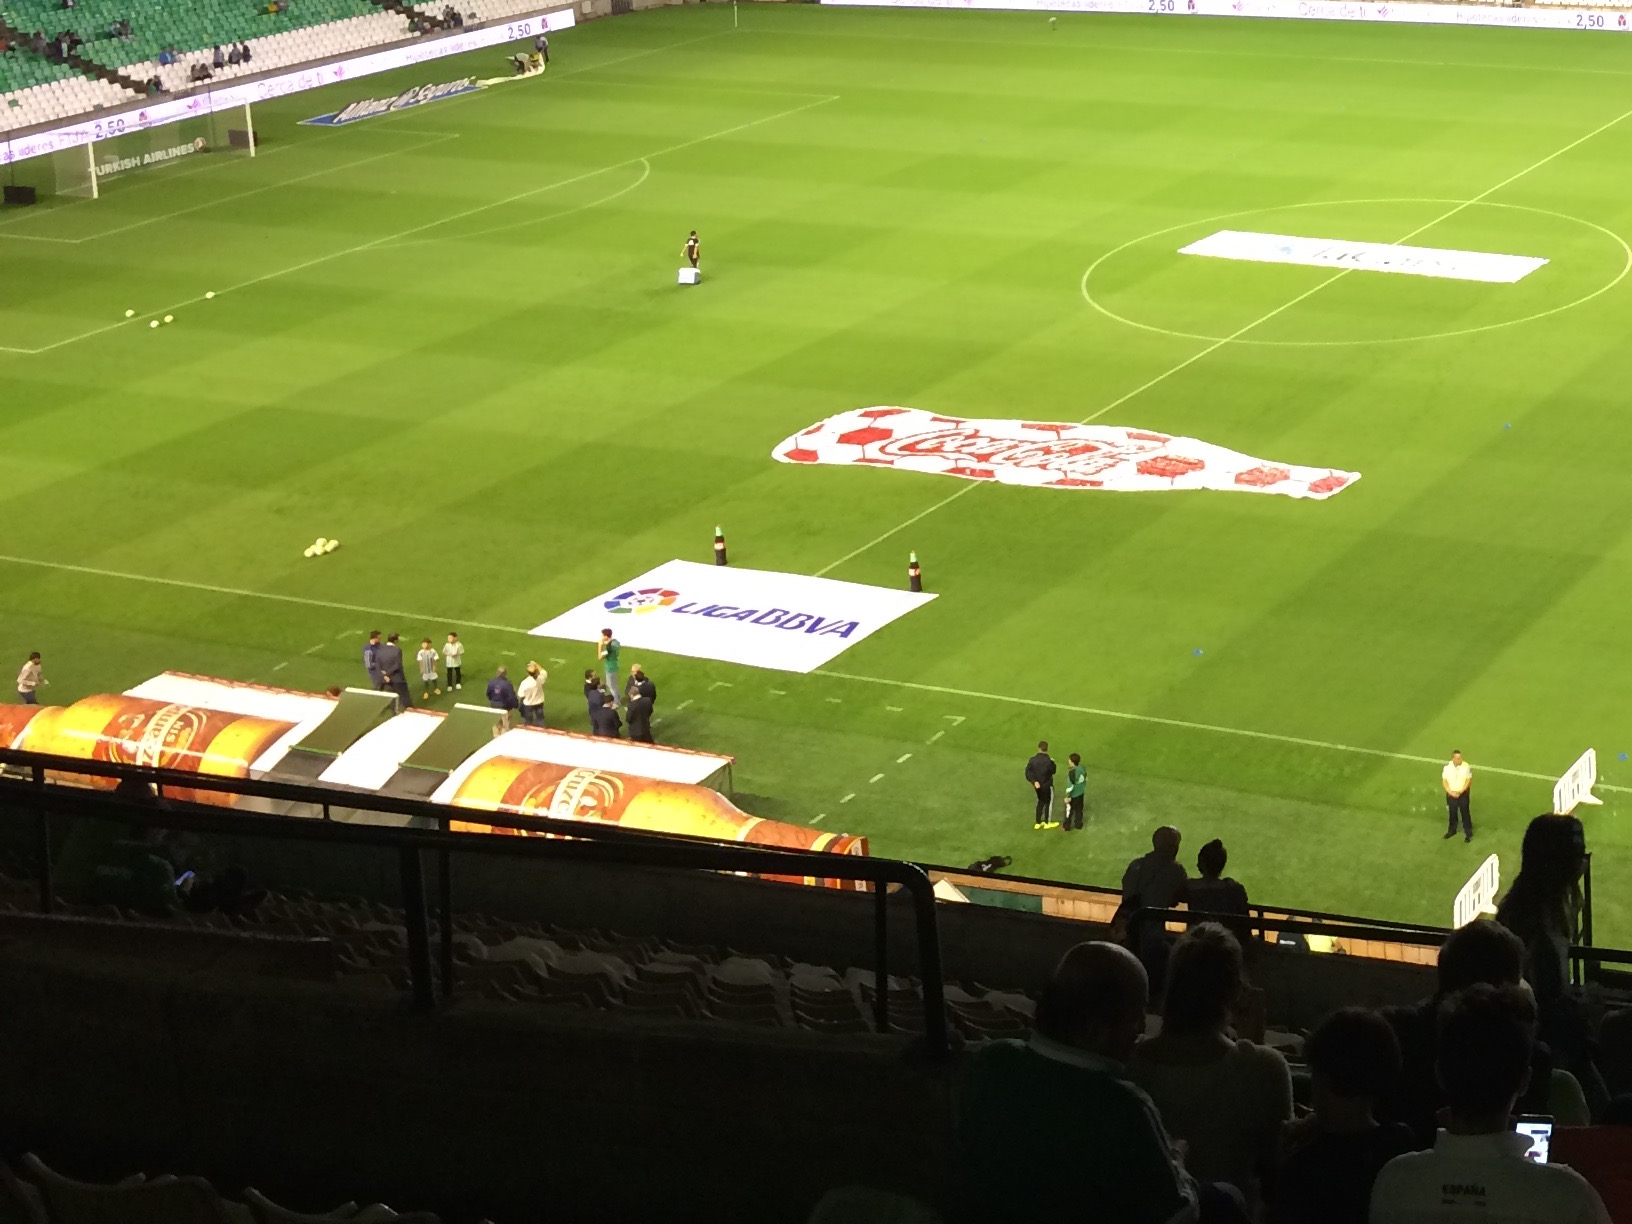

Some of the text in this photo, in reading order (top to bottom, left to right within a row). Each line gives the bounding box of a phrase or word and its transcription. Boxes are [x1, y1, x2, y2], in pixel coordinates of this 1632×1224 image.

[507, 22, 532, 40] 2,50
[1576, 13, 1605, 30] 2,50
[94, 119, 126, 140] 2,50
[143, 142, 195, 164] AIRLINES
